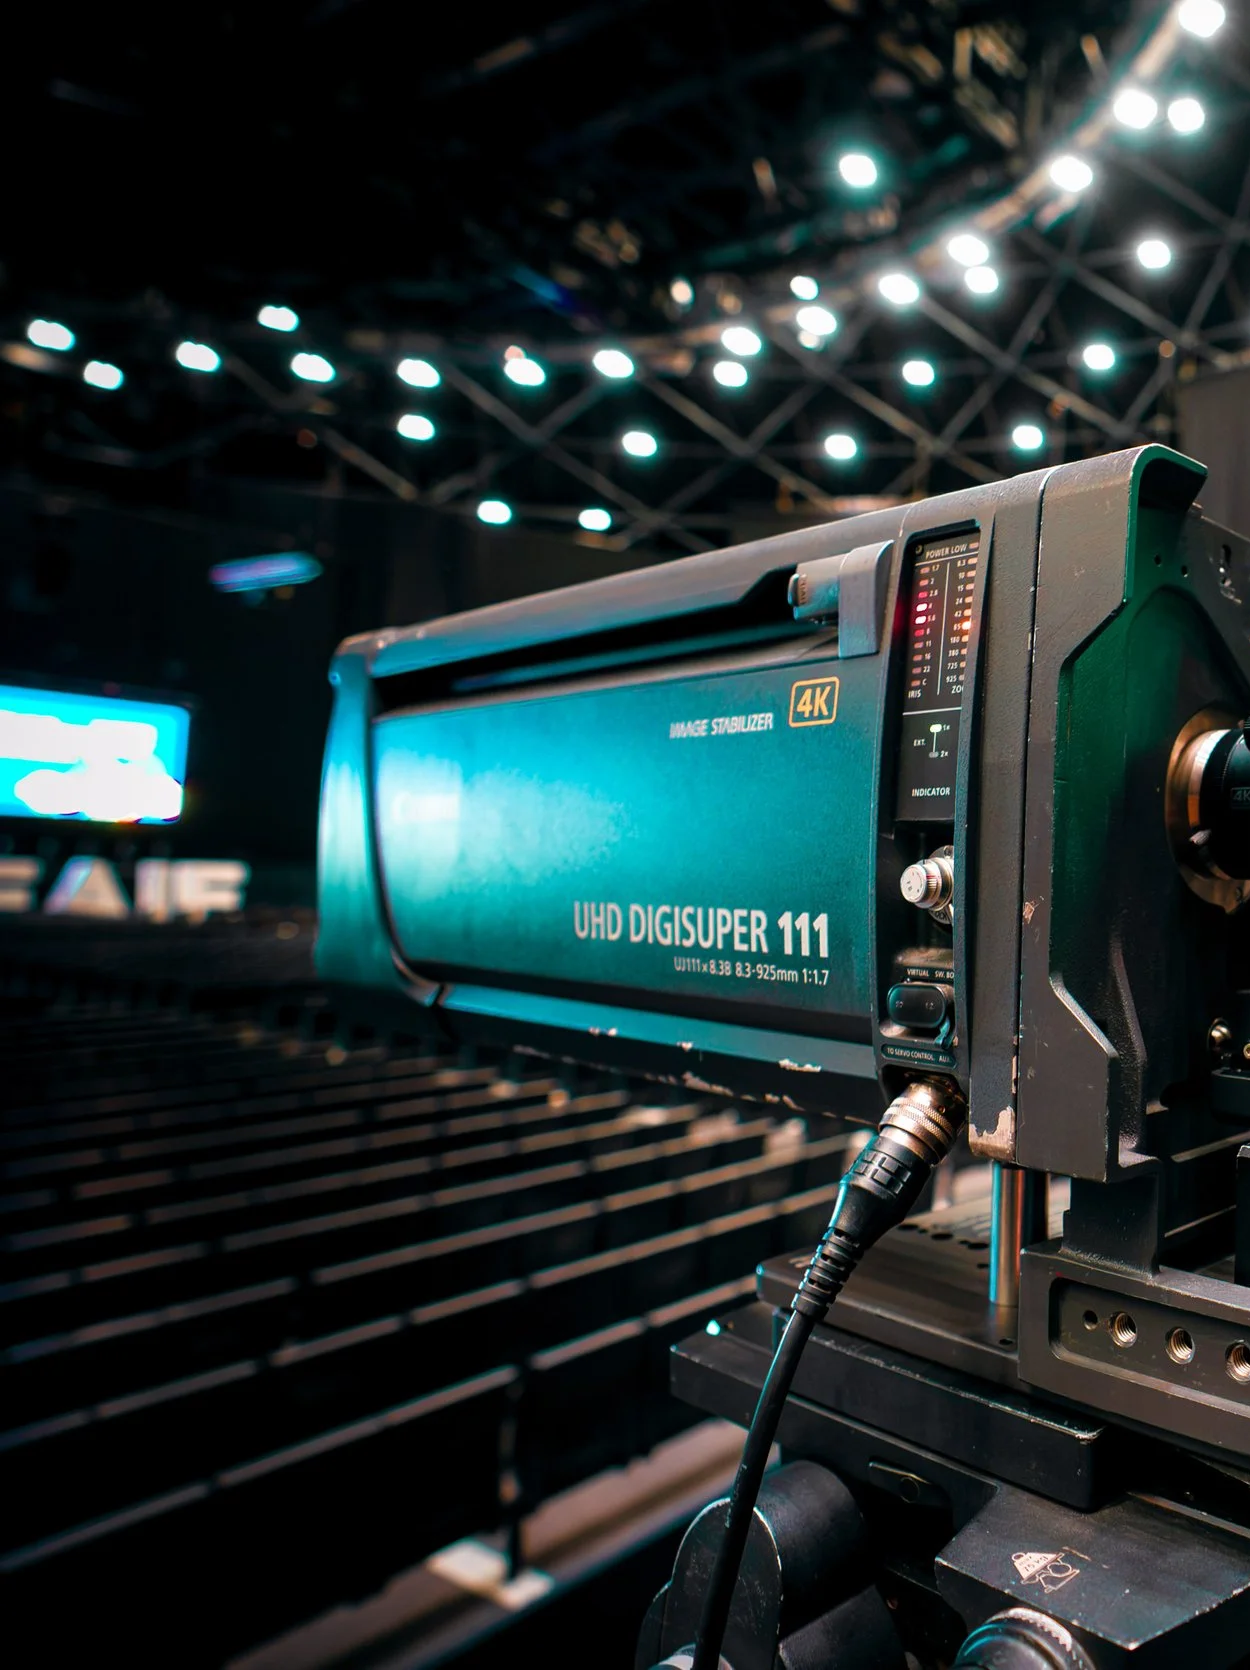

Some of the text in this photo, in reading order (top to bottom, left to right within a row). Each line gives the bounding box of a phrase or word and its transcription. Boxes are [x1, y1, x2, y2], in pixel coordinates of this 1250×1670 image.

[925, 543, 967, 559] POWER LOW
[955, 597, 963, 605] 24
[908, 689, 921, 699] IRIS
[796, 685, 831, 718] 4K
[669, 712, 774, 739] IMAGE STABILIZER
[911, 786, 950, 797] INDICATOR
[574, 900, 829, 958] UHD DIGISUPER 111
[735, 962, 799, 983] 8.3-925mm
[802, 968, 829, 986] 1:1.7
[907, 968, 929, 977] VIRTUAL
[887, 1047, 895, 1055] TO
[895, 1048, 911, 1057] SERVO
[911, 1050, 934, 1060] CONTROL
